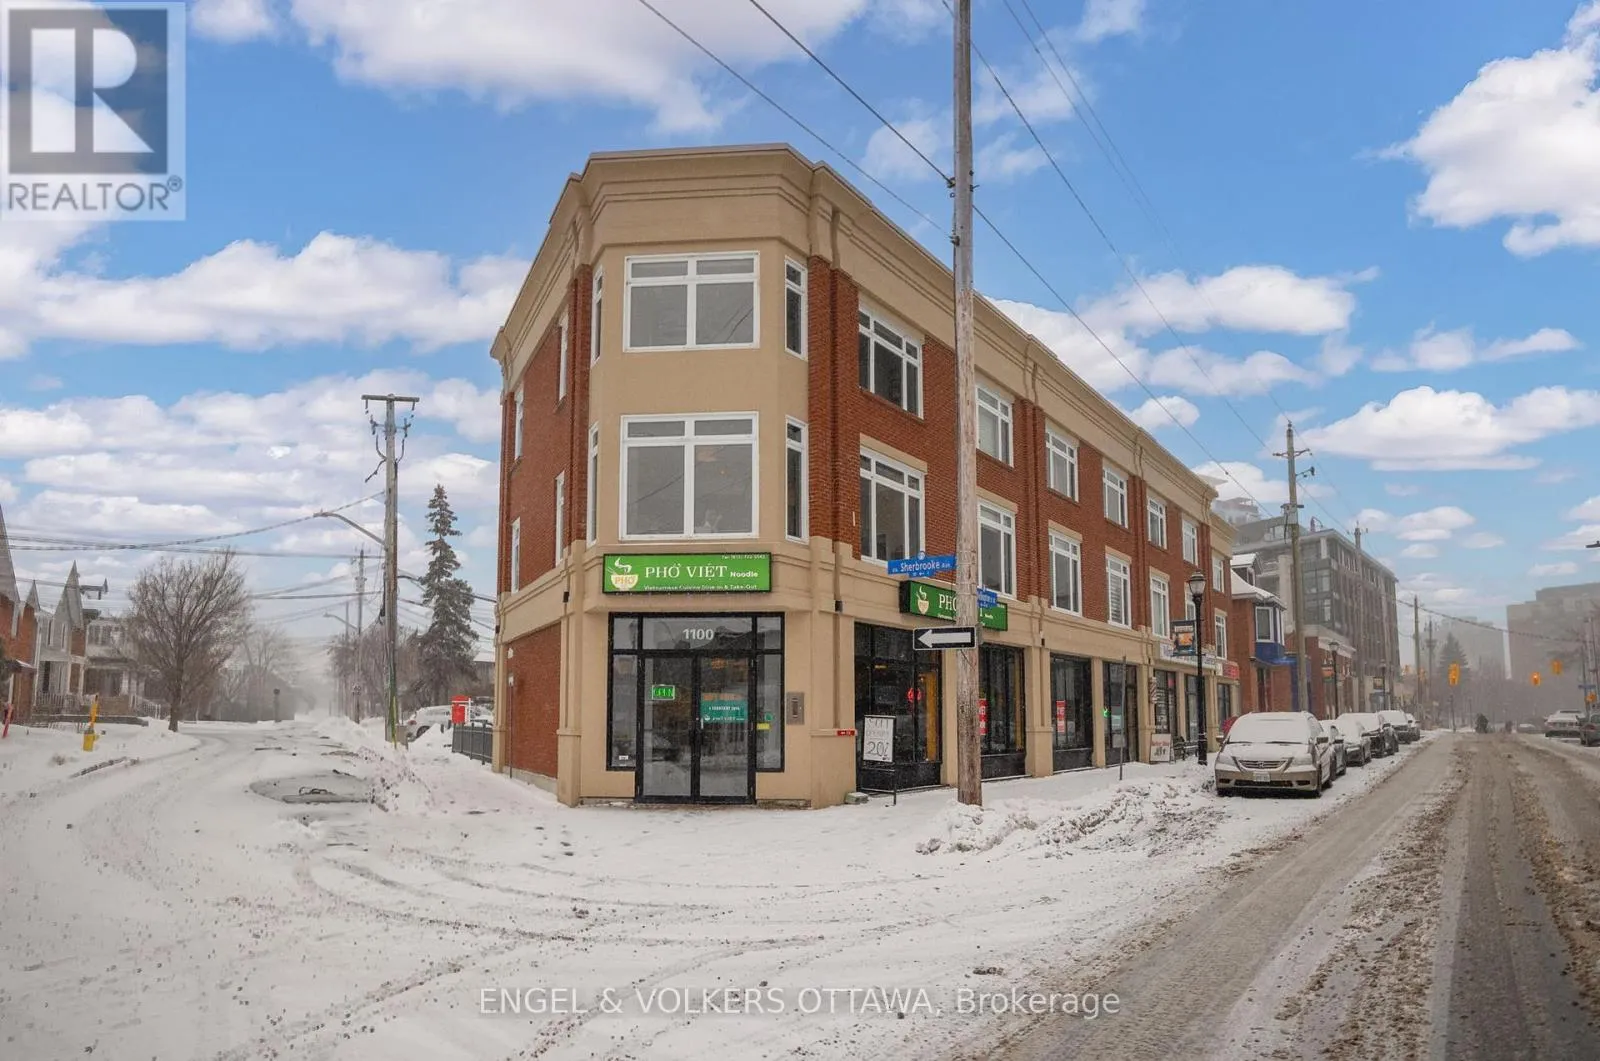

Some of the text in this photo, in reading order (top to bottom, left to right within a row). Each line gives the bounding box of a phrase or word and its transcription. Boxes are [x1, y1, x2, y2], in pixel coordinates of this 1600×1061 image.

[900, 560, 940, 572] Sherbrooke
[730, 570, 759, 578] Noodle
[683, 628, 715, 641] 1100
